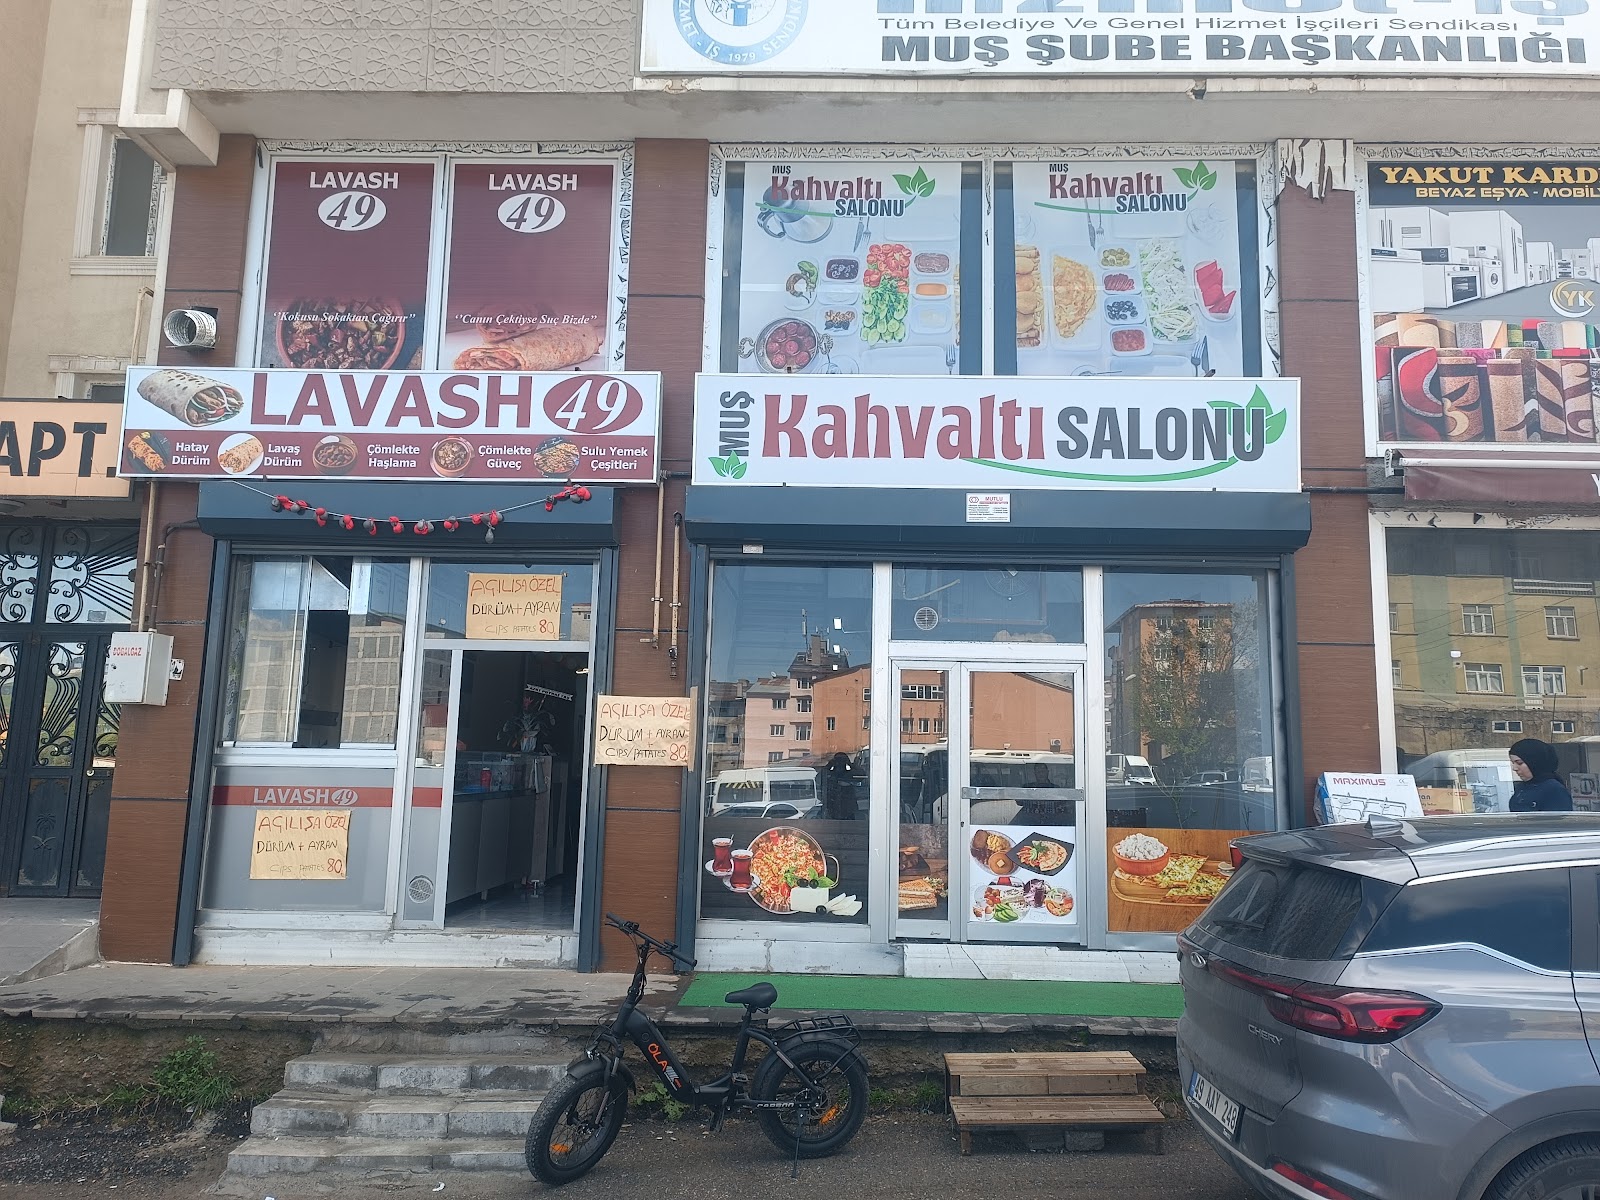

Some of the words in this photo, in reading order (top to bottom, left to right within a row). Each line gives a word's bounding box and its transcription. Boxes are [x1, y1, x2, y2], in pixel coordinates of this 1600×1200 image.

[878, 18, 934, 30] Tüm
[945, 18, 1054, 32] Belediye
[1064, 18, 1097, 29] Ve
[1108, 17, 1184, 29] Genel
[1195, 17, 1286, 30] Hizmet
[1296, 16, 1378, 31] İşçileri
[1389, 18, 1517, 31] Sendikası
[882, 34, 1009, 67] MUŞ
[1026, 34, 1192, 66] ŞUBE
[1205, 31, 1587, 66] BAŞKANLIĞI
[729, 52, 756, 62] 1979
[772, 165, 791, 174] MUŞ
[1049, 163, 1069, 173] MUŞ
[309, 171, 399, 189] LAVASH
[488, 173, 578, 191] LAVASH
[1379, 167, 1495, 184] YAKUT
[1502, 167, 1600, 184] KARD
[771, 175, 882, 200] Kahvaltı
[1050, 171, 1163, 199] Kahvaltı
[1415, 187, 1476, 198] BEYAZ
[1480, 187, 1529, 202] EŞYA
[1543, 185, 1600, 198] MOBİL
[835, 199, 905, 217] SALONU
[1116, 194, 1188, 213] SALONU
[326, 194, 376, 228] 49
[506, 196, 555, 230] 49
[321, 311, 369, 322] Sokaktan
[496, 314, 537, 326] Çektiyse
[540, 314, 559, 326] Suç
[250, 373, 533, 429] LAVASH
[555, 379, 629, 431] 49
[719, 390, 755, 457] MUŞ
[762, 393, 1045, 461] Kahvaltı
[1057, 405, 1265, 462] SALONU
[175, 442, 209, 455] Hatay
[268, 443, 301, 456] Lavaş
[367, 444, 420, 456] Çömlekte
[478, 445, 532, 457] Çömlekte
[581, 446, 606, 456] Sulu
[609, 447, 648, 457] Yemek
[172, 455, 211, 466] Dürüm
[263, 457, 302, 467] Dürüm
[368, 457, 417, 470] Haşlama
[486, 459, 522, 471] Güveç
[590, 459, 638, 472] Çeşitleri
[656, 728, 686, 740] AYRAN
[1332, 777, 1386, 786] MAXIMUS
[253, 788, 329, 804] LAVASH
[334, 790, 355, 804] 49
[256, 840, 295, 854] DÜRÜM
[308, 840, 338, 851] AYRAN
[1247, 1023, 1283, 1046] CHERY
[1205, 1086, 1221, 1115] AAY
